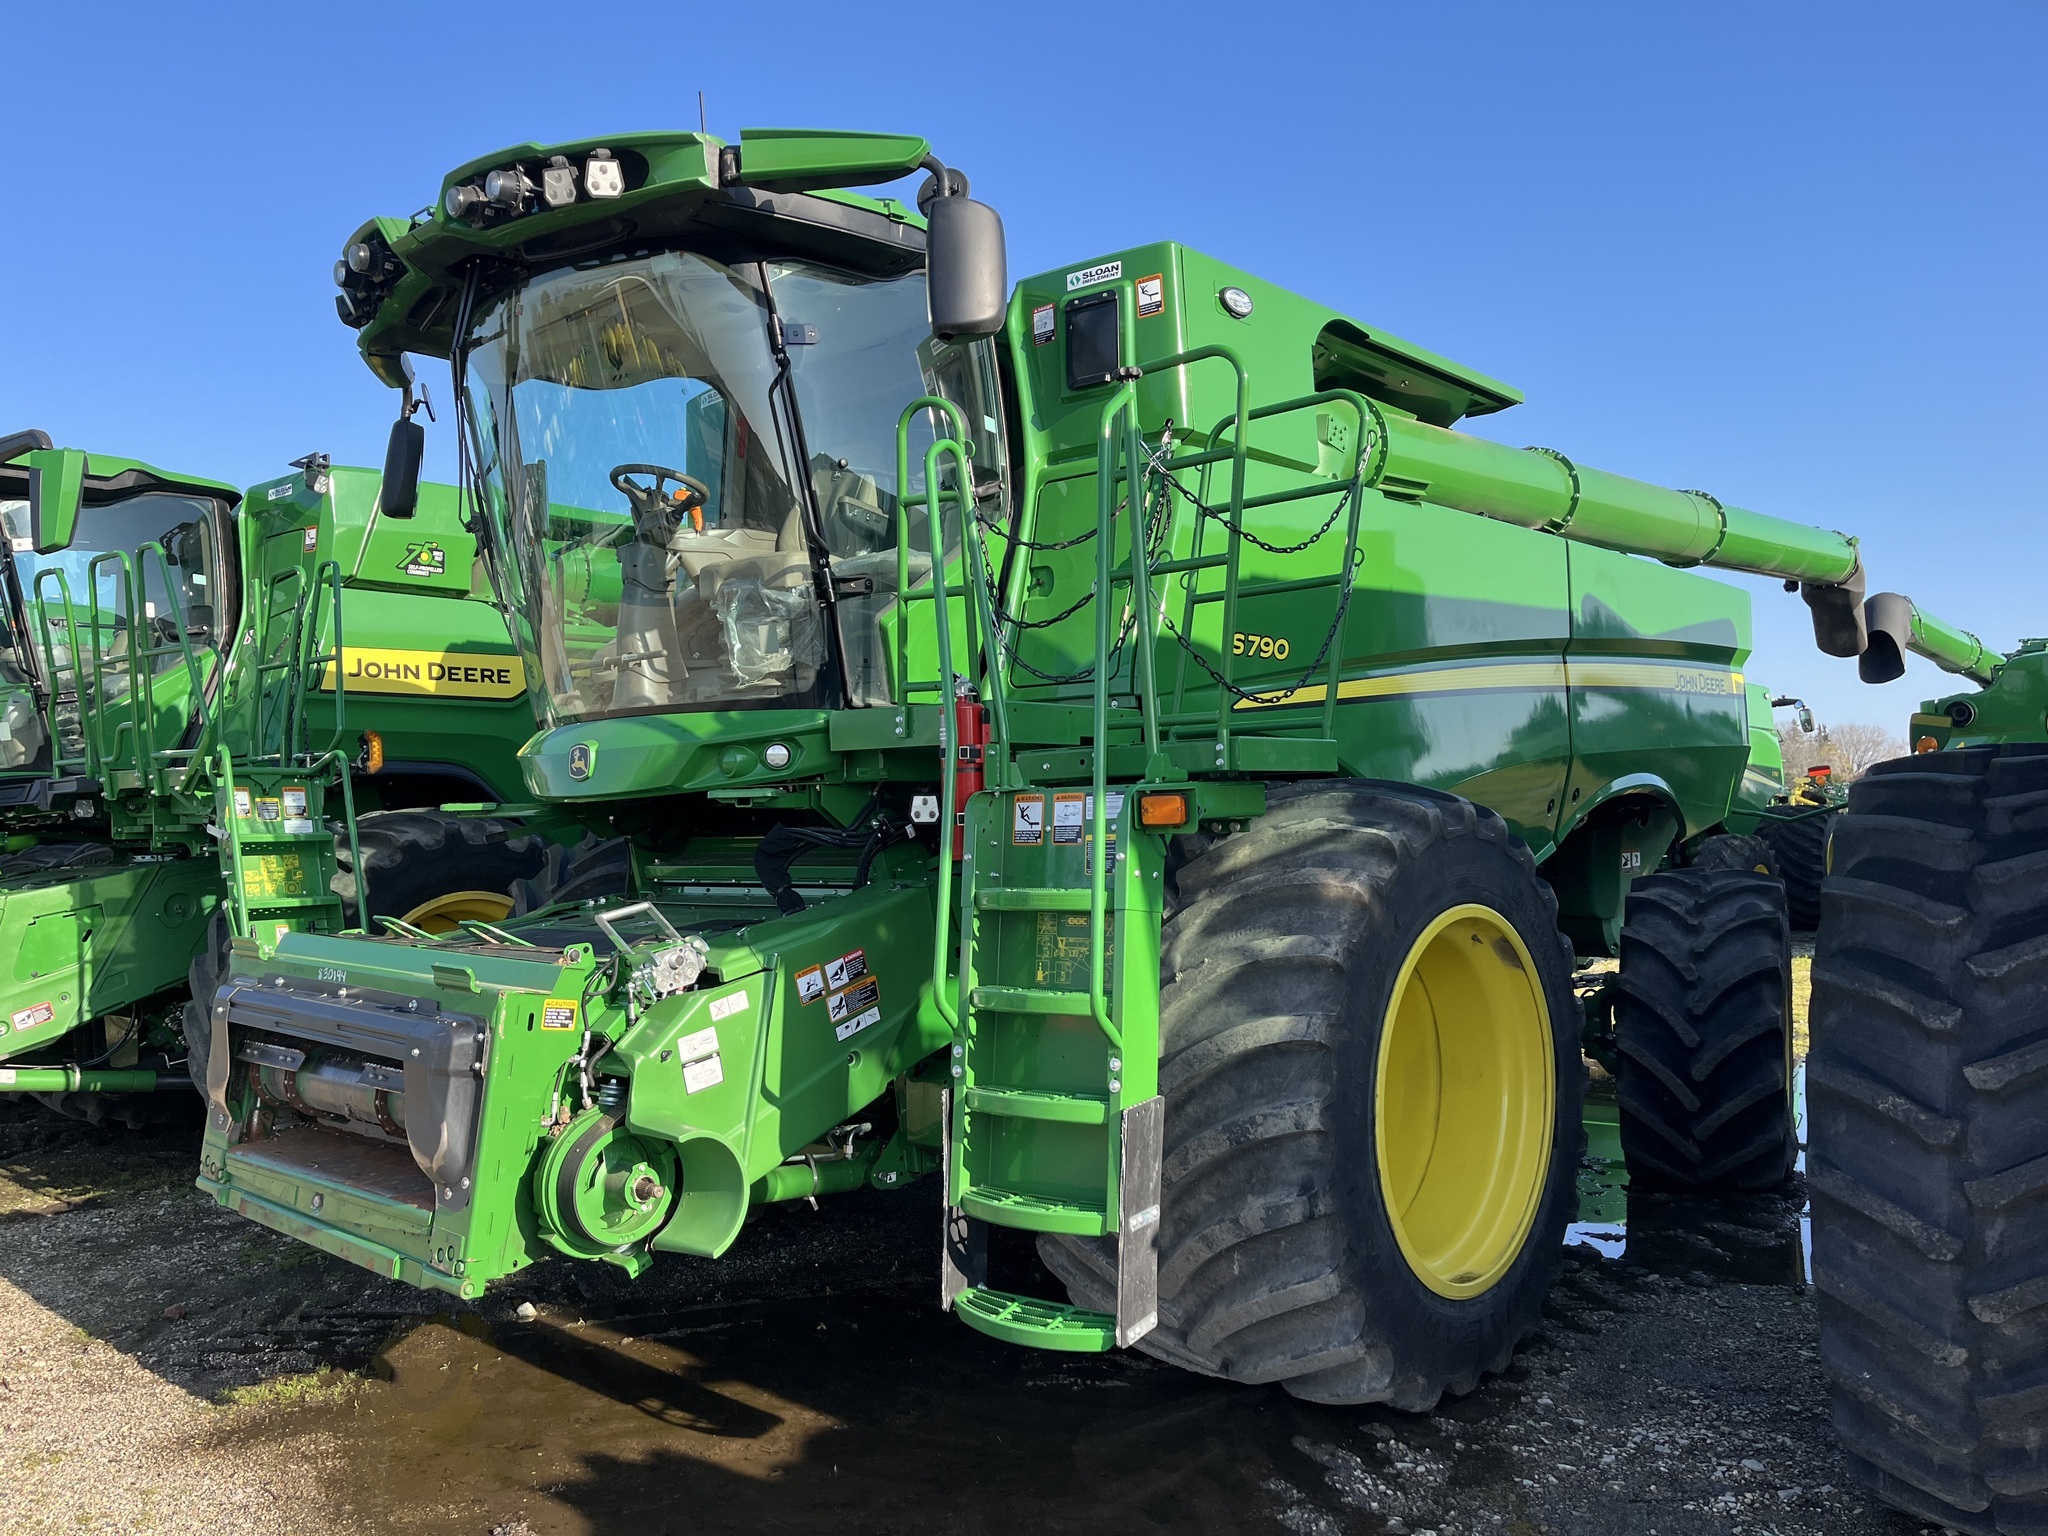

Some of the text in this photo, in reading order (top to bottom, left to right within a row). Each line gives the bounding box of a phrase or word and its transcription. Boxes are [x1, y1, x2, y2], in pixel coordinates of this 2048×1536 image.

[1082, 264, 1119, 280] SLOAN
[1082, 271, 1119, 285] IMPLEMENT
[396, 541, 438, 569] 75
[1233, 632, 1290, 661] S790
[348, 658, 420, 680] JOHN
[428, 661, 511, 685] DEERE
[1675, 670, 1727, 694] JOHN DEERE
[318, 967, 347, 982] 830194
